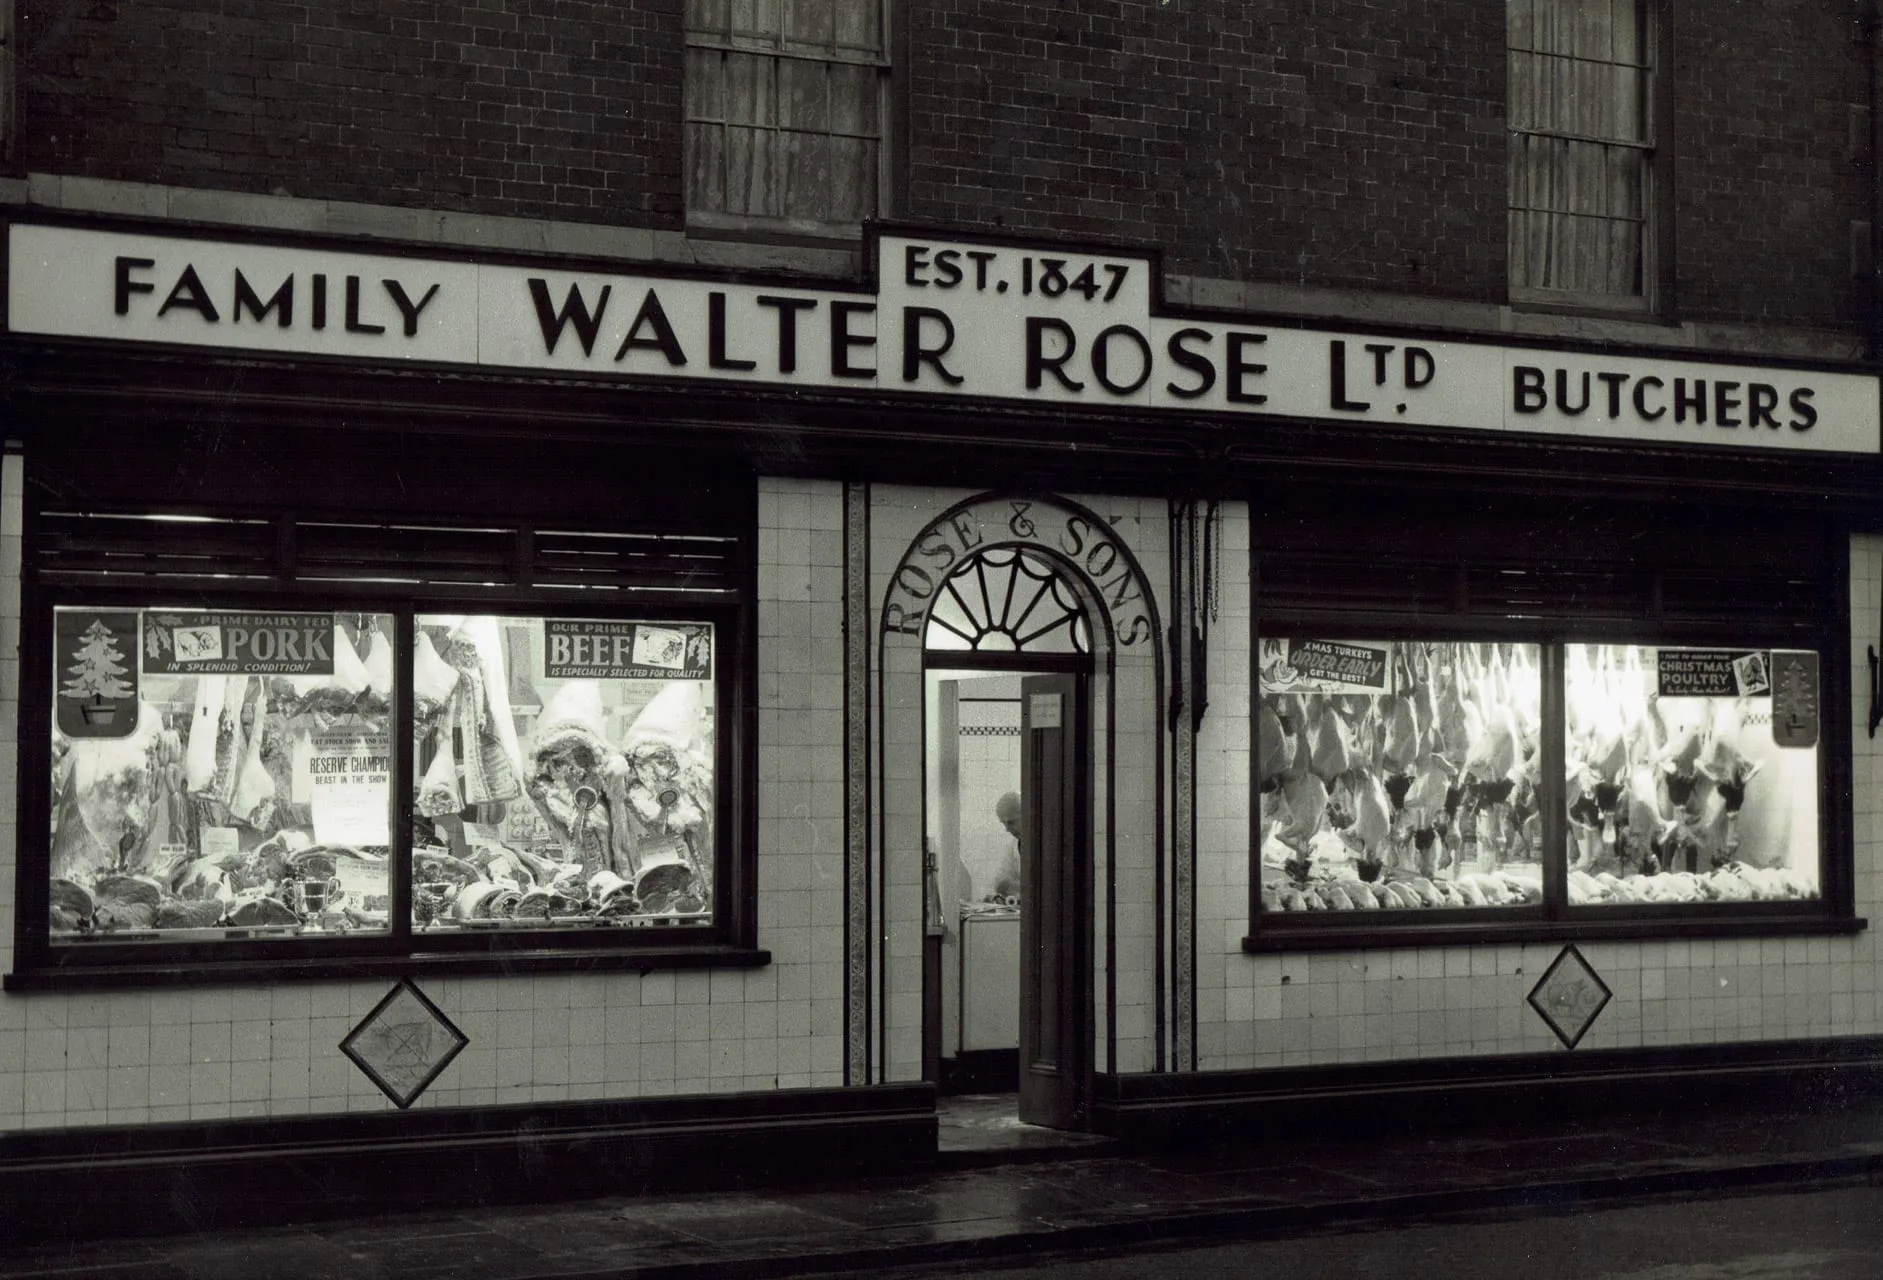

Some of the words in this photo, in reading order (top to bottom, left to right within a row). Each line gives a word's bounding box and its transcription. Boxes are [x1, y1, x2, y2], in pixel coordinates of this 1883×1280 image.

[905, 246, 1009, 294] EST.
[1022, 257, 1130, 301] 1847
[114, 255, 440, 336] FAMILY
[528, 278, 964, 384] WALTER
[1025, 316, 1268, 405] ROSE
[1513, 365, 1818, 432] BUTCHERS
[885, 510, 983, 637] ROSE
[1008, 501, 1039, 539] &
[1060, 516, 1150, 646] SONS
[200, 615, 250, 626] PRIME
[254, 616, 298, 627] DAIRY
[304, 617, 330, 627] FED
[552, 623, 579, 633] OUR
[585, 623, 629, 634] PRIME
[226, 627, 330, 661] PORK
[550, 634, 630, 666] BEEF
[1303, 642, 1332, 654] XMAS
[1334, 646, 1372, 660] TURKEYS
[167, 662, 180, 671] IN
[187, 662, 238, 672] SPLENDID
[244, 662, 311, 672] CONDITION!
[1290, 649, 1338, 670] ORDER
[1337, 656, 1382, 677] EARLY
[1660, 661, 1732, 672] CHRISTMAS
[551, 667, 559, 675] IS
[562, 667, 607, 676] ESPECIALLY
[610, 668, 648, 677] SELECTED
[649, 668, 665, 677] FOR
[666, 669, 704, 678] QUALITY
[1309, 669, 1325, 677] GET
[1326, 671, 1340, 680] THE
[1662, 674, 1728, 685] POULTRY
[310, 756, 347, 774] RESERVE
[315, 775, 336, 785] BEAST
[340, 775, 347, 784] IN
[352, 775, 364, 784] THE
[368, 775, 387, 784] SHOW
